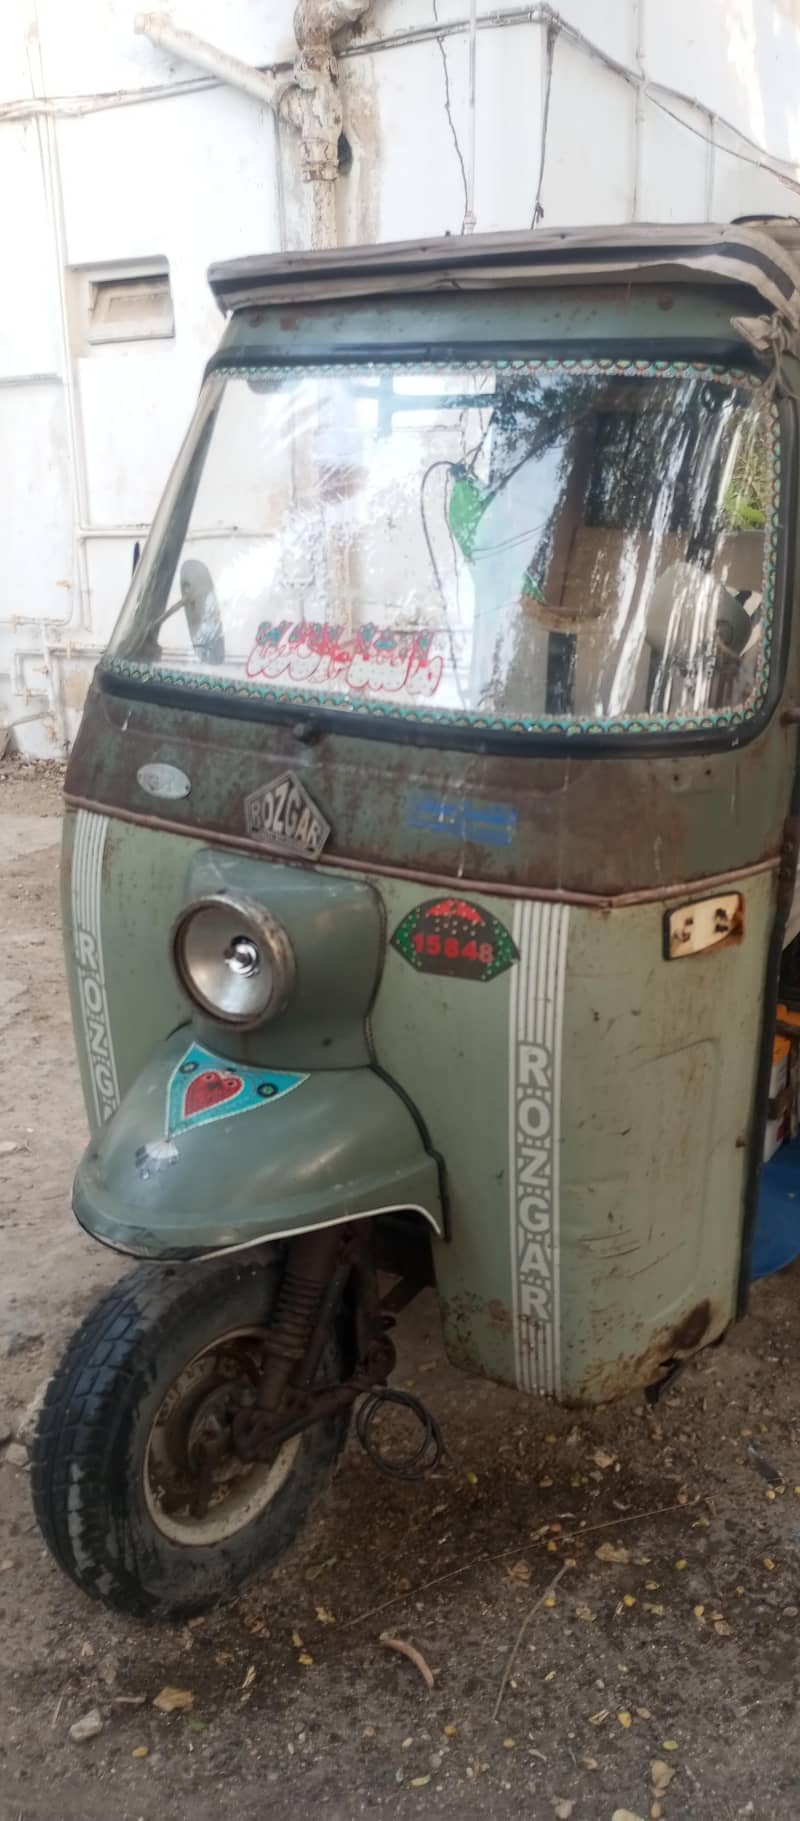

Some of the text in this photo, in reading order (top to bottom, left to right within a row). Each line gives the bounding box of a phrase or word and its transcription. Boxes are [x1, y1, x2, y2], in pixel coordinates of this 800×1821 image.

[250, 782, 321, 848] ROZGAR
[412, 933, 494, 964] 15848
[517, 1044, 550, 1319] ROZGAR
